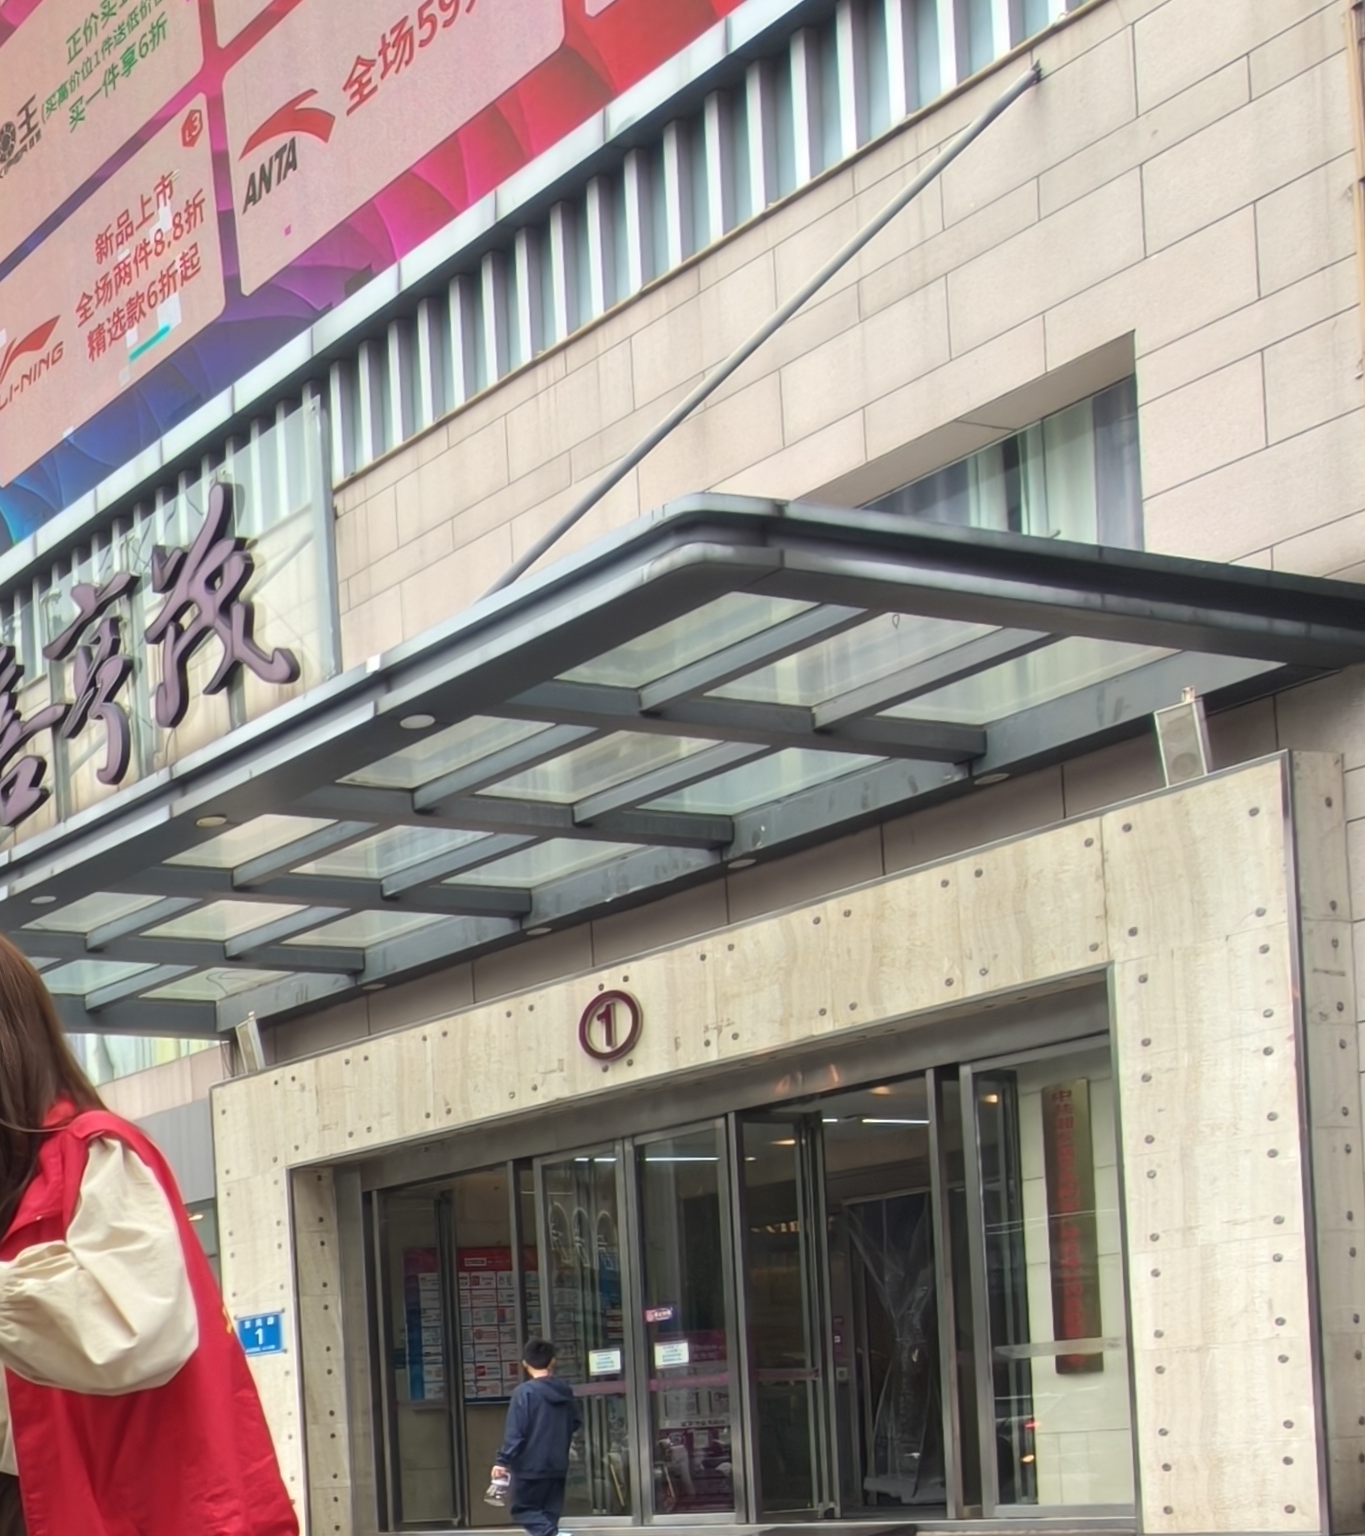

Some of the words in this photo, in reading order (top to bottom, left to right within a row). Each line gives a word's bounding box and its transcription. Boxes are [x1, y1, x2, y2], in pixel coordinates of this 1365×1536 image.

[41, 0, 167, 124] （买高价位1件送低价
[67, 0, 130, 65] 正价买
[70, 12, 168, 133] 买一件享6折
[342, 0, 473, 117] 全场59
[95, 171, 174, 264] 新品上市
[242, 137, 298, 214] ANTA
[76, 188, 205, 328] 全场两件8.8折
[86, 242, 202, 362] 精选款6折起
[255, 1328, 263, 1345] 1
